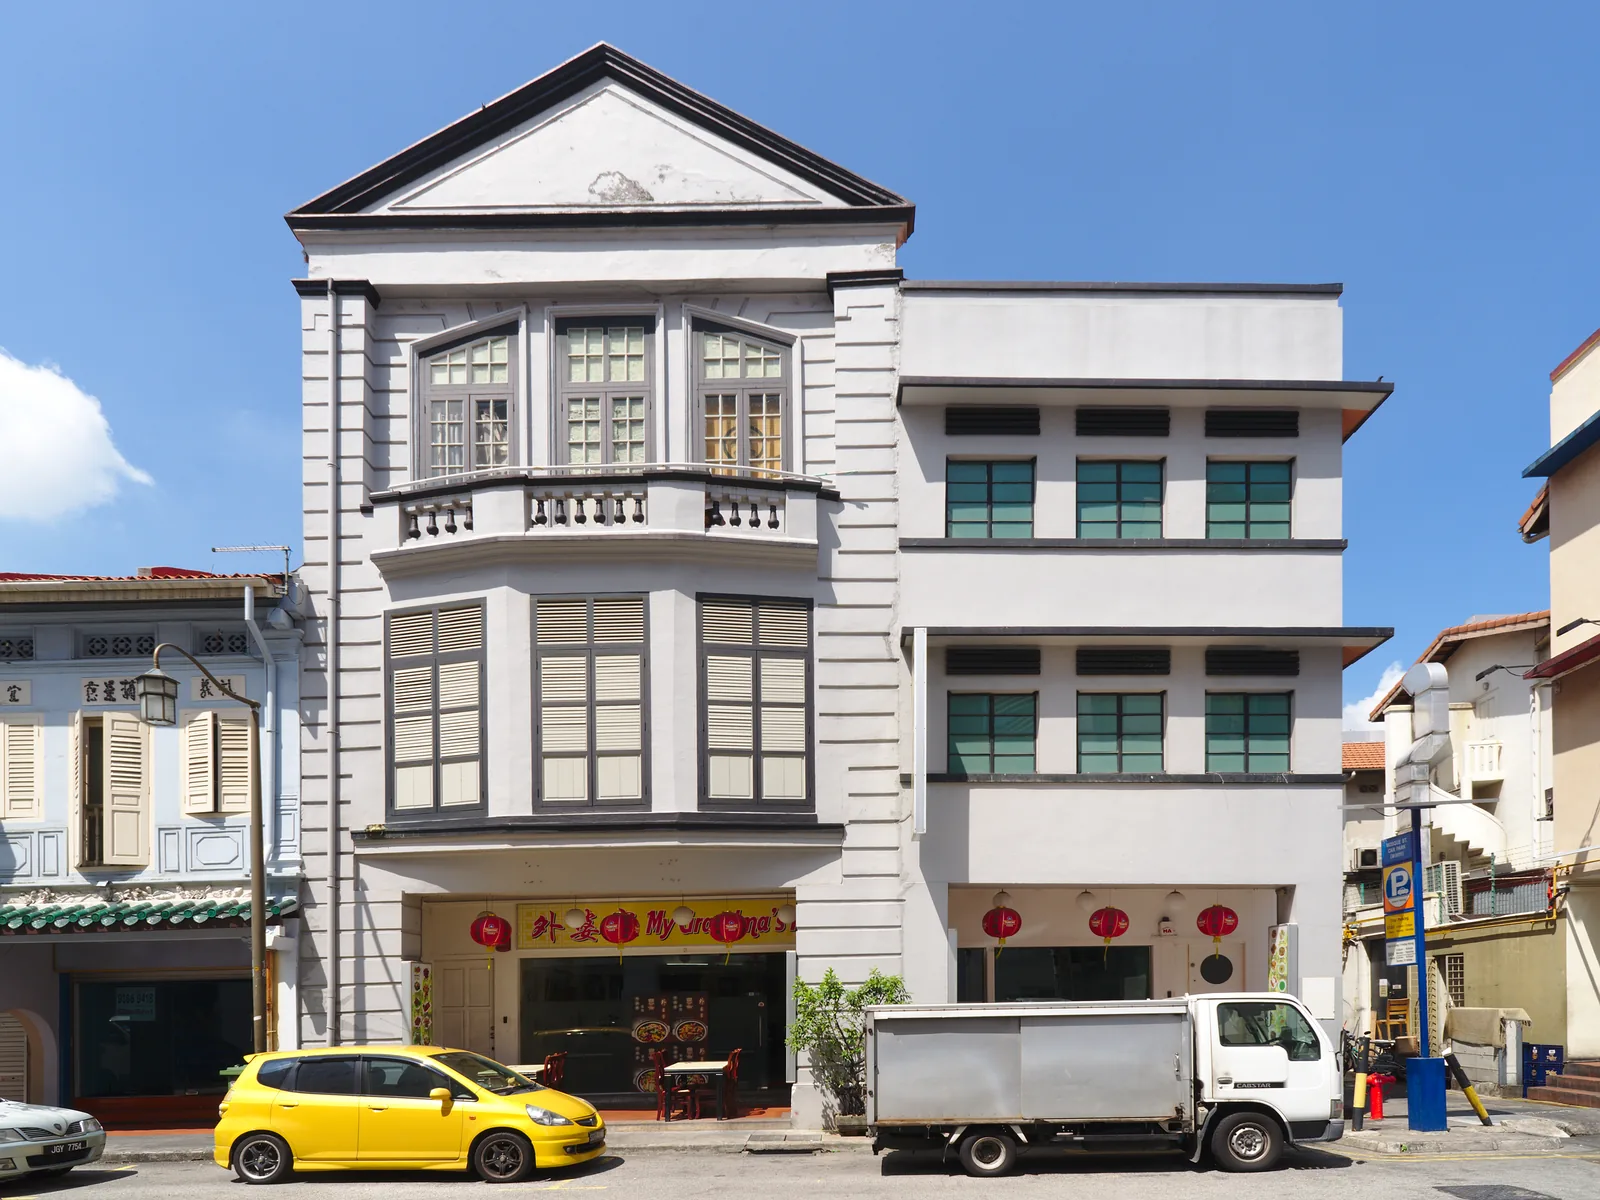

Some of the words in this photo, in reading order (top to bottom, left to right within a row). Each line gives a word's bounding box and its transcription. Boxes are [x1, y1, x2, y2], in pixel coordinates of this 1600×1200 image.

[1391, 871, 1409, 897] P
[646, 909, 675, 941] My
[51, 1145, 65, 1154] JGY
